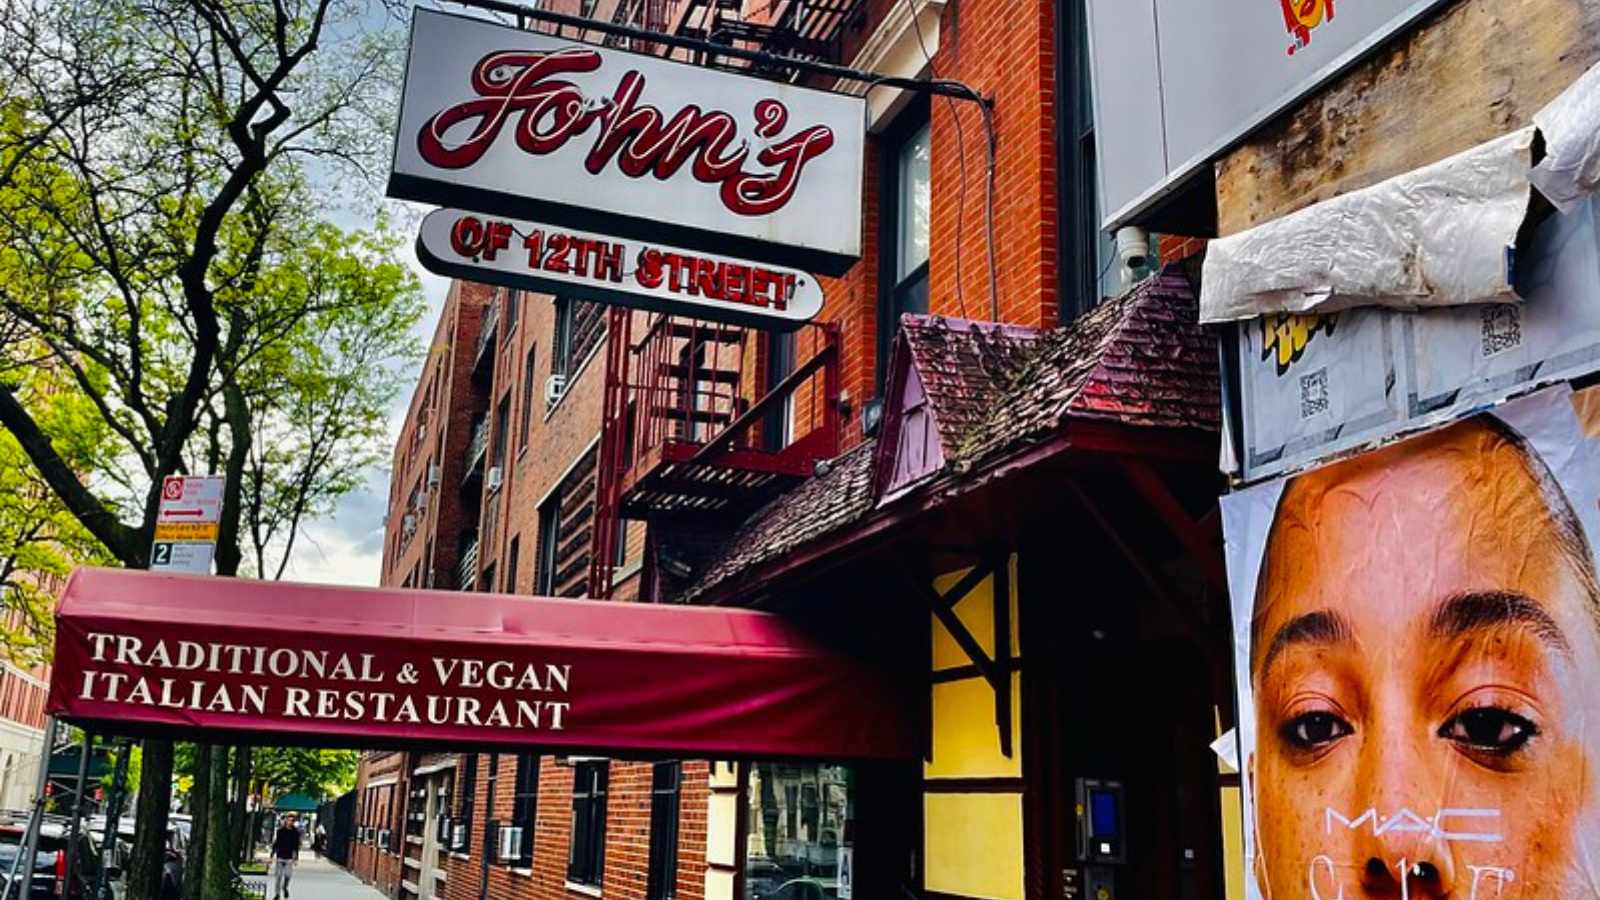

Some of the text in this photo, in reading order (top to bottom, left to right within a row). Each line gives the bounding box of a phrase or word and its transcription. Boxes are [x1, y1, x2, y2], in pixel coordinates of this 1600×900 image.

[417, 47, 834, 216] John's
[451, 216, 796, 310] OF 12TH STREET
[156, 544, 168, 562] 2
[87, 632, 572, 692] TRADITIONAL & VEGAN
[78, 670, 570, 730] ITALIAN RESTAURANT
